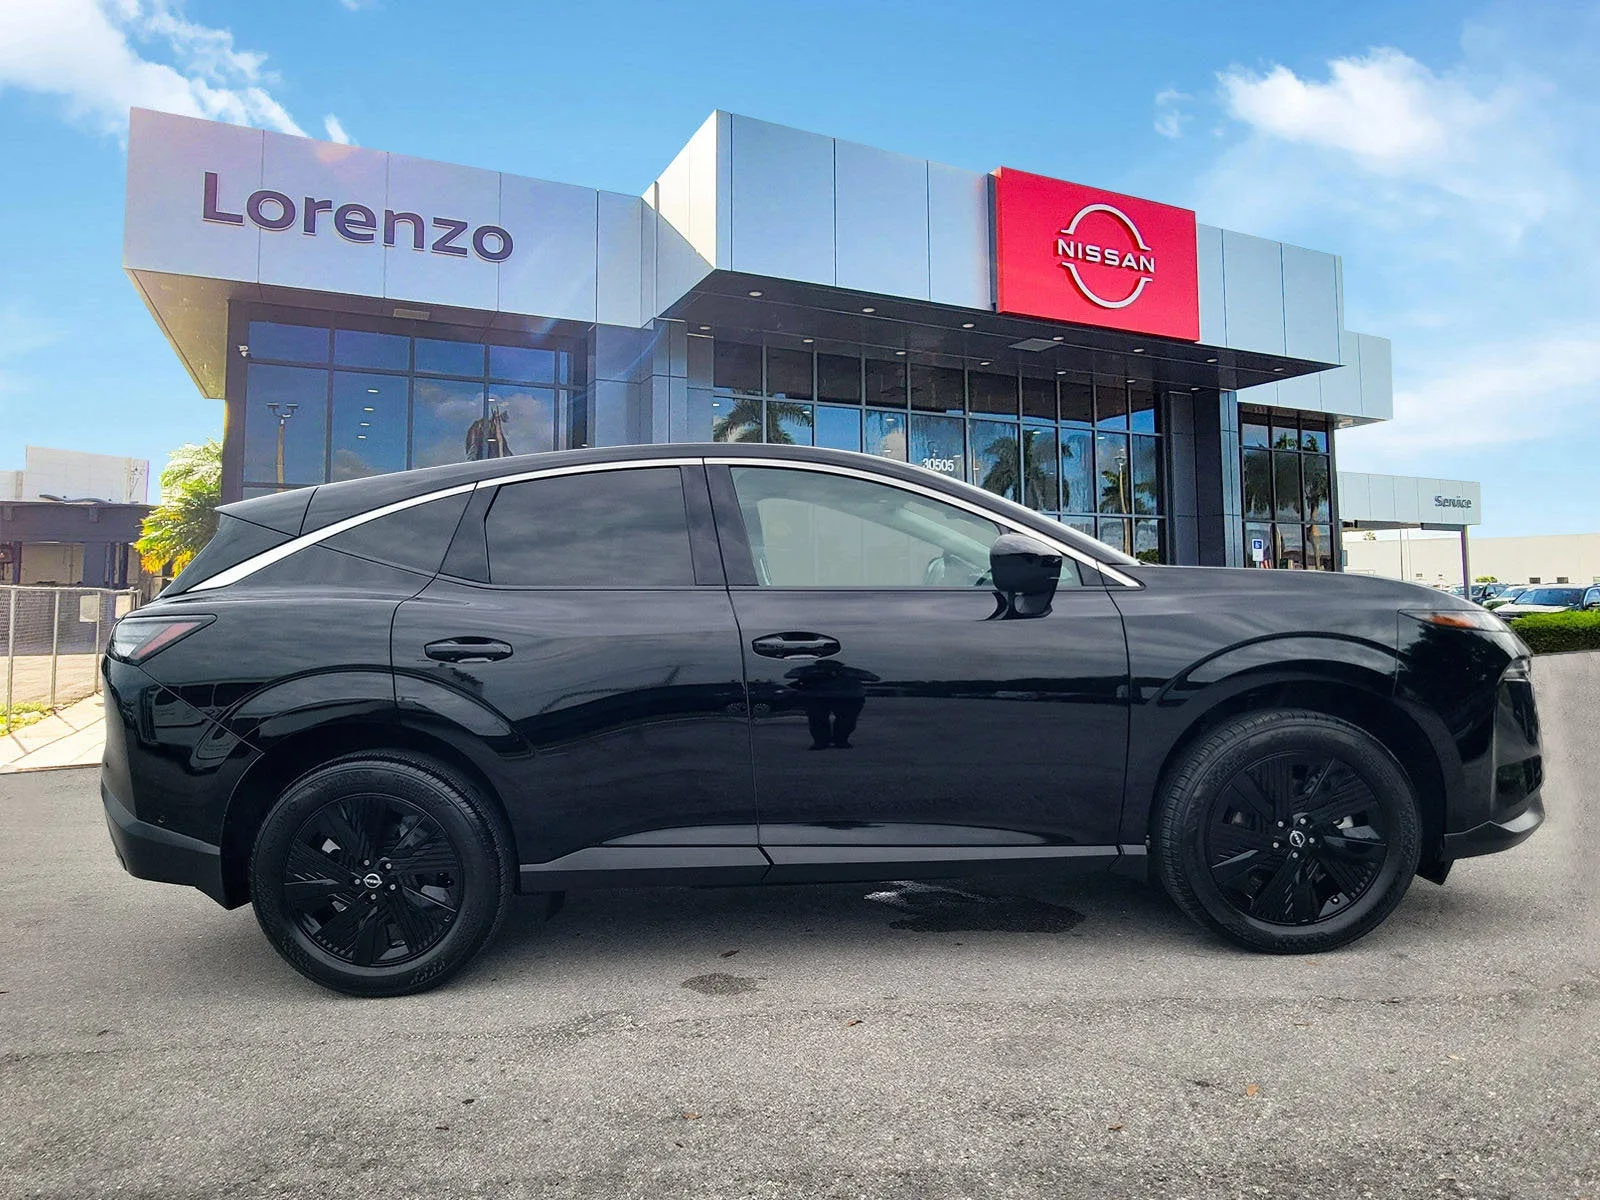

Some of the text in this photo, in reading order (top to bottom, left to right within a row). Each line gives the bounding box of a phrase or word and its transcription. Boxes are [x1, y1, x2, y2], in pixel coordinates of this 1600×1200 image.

[202, 171, 514, 262] Lorenzo
[1057, 238, 1155, 273] NISSAN
[922, 458, 955, 471] 30505
[1434, 495, 1472, 508] Service
